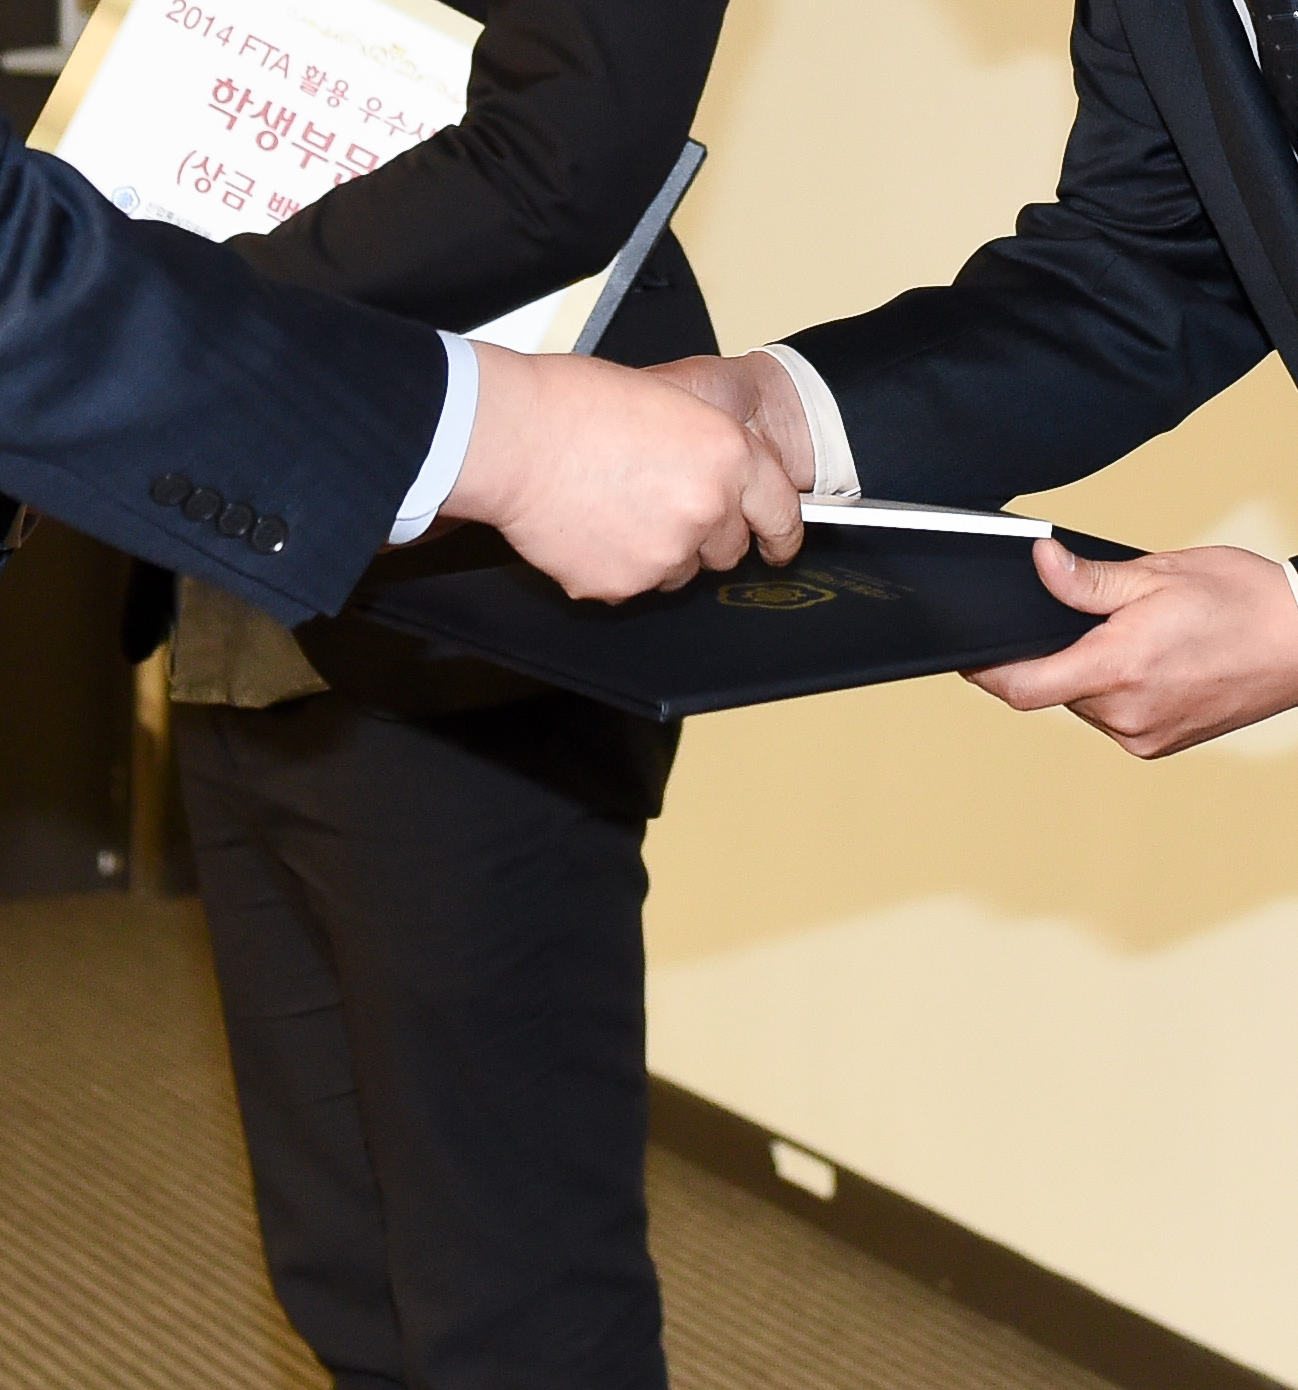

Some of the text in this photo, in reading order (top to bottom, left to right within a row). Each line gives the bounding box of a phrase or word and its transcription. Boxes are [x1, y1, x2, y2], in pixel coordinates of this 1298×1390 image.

[238, 34, 291, 79] FTA
[300, 64, 349, 109] 활용
[177, 150, 257, 212] (상금
